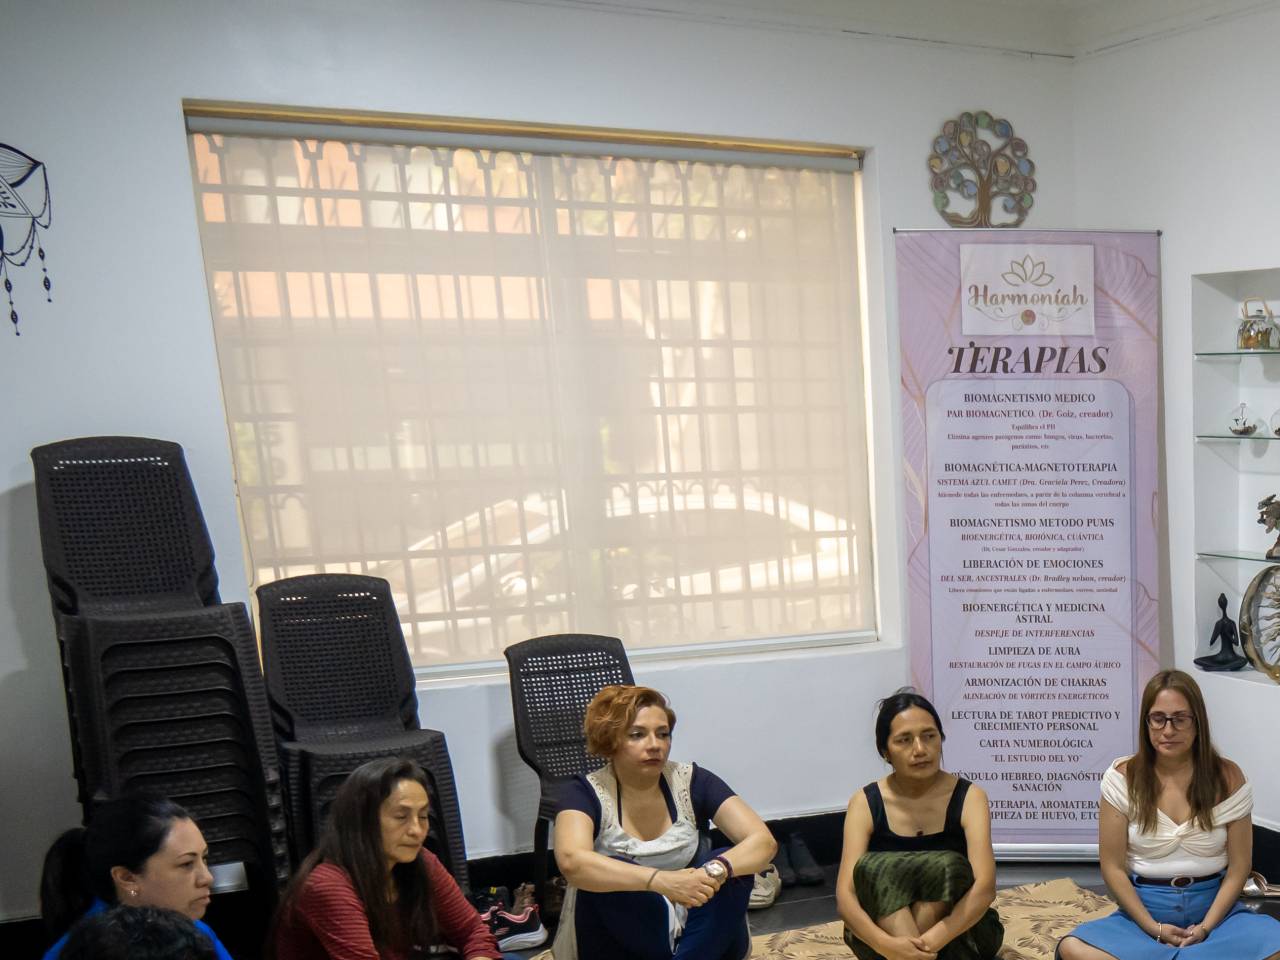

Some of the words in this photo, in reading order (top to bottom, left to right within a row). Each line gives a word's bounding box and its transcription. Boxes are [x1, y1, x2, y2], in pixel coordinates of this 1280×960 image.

[948, 341, 1109, 374] TERAPIAS
[964, 394, 1051, 403] BIOMAGNETISMO
[1054, 394, 1095, 403] MEDICO
[947, 410, 964, 418] PAR
[1039, 410, 1054, 419] (Dr.
[1079, 410, 1113, 419] creador)
[944, 462, 1117, 472] BIOMAGNÉTICA-MAGNETOTERAPIA
[950, 518, 1036, 527] BIOMAGNETISMO
[1039, 518, 1084, 527] METODO
[1087, 518, 1115, 527] PUMS
[963, 558, 1023, 568] LIBERACIÓN
[1026, 560, 1040, 568] DE
[1043, 560, 1104, 568] EMOCIONES
[962, 602, 1043, 612] BIOENERGÉTICA
[1046, 604, 1052, 612] Y
[1055, 604, 1105, 612] MEDICINA
[1015, 615, 1053, 623] ASTRAL
[975, 629, 1010, 637] DESPEJE
[1012, 629, 1024, 637] DE
[1025, 629, 1095, 637] INTERFERENCIAS
[988, 647, 1035, 655] LIMPIEZA
[1038, 647, 1052, 655] DE
[1054, 647, 1080, 655] AURA
[949, 661, 1004, 669] RESTAURACIÓN
[965, 676, 1041, 687] ARMONIZACIÓN
[1044, 678, 1058, 687] DE
[1061, 678, 1107, 687] CHAKRAS
[951, 711, 997, 720] LECTURA
[1000, 711, 1013, 720] DE
[1016, 711, 1048, 720] TAROT
[1051, 711, 1112, 720] PREDICTIVO
[1114, 711, 1120, 720] Y
[974, 722, 1044, 731] CRECIMIENTO
[1047, 722, 1099, 731] PERSONAL
[979, 740, 1010, 748] CARTA
[1013, 738, 1093, 748] NUMEROLÓGICA
[1002, 772, 1044, 781] HEBREO,
[1012, 782, 1062, 792] SANACIÓN
[1025, 811, 1039, 820] DE
[1042, 811, 1078, 821] HUEVO,
